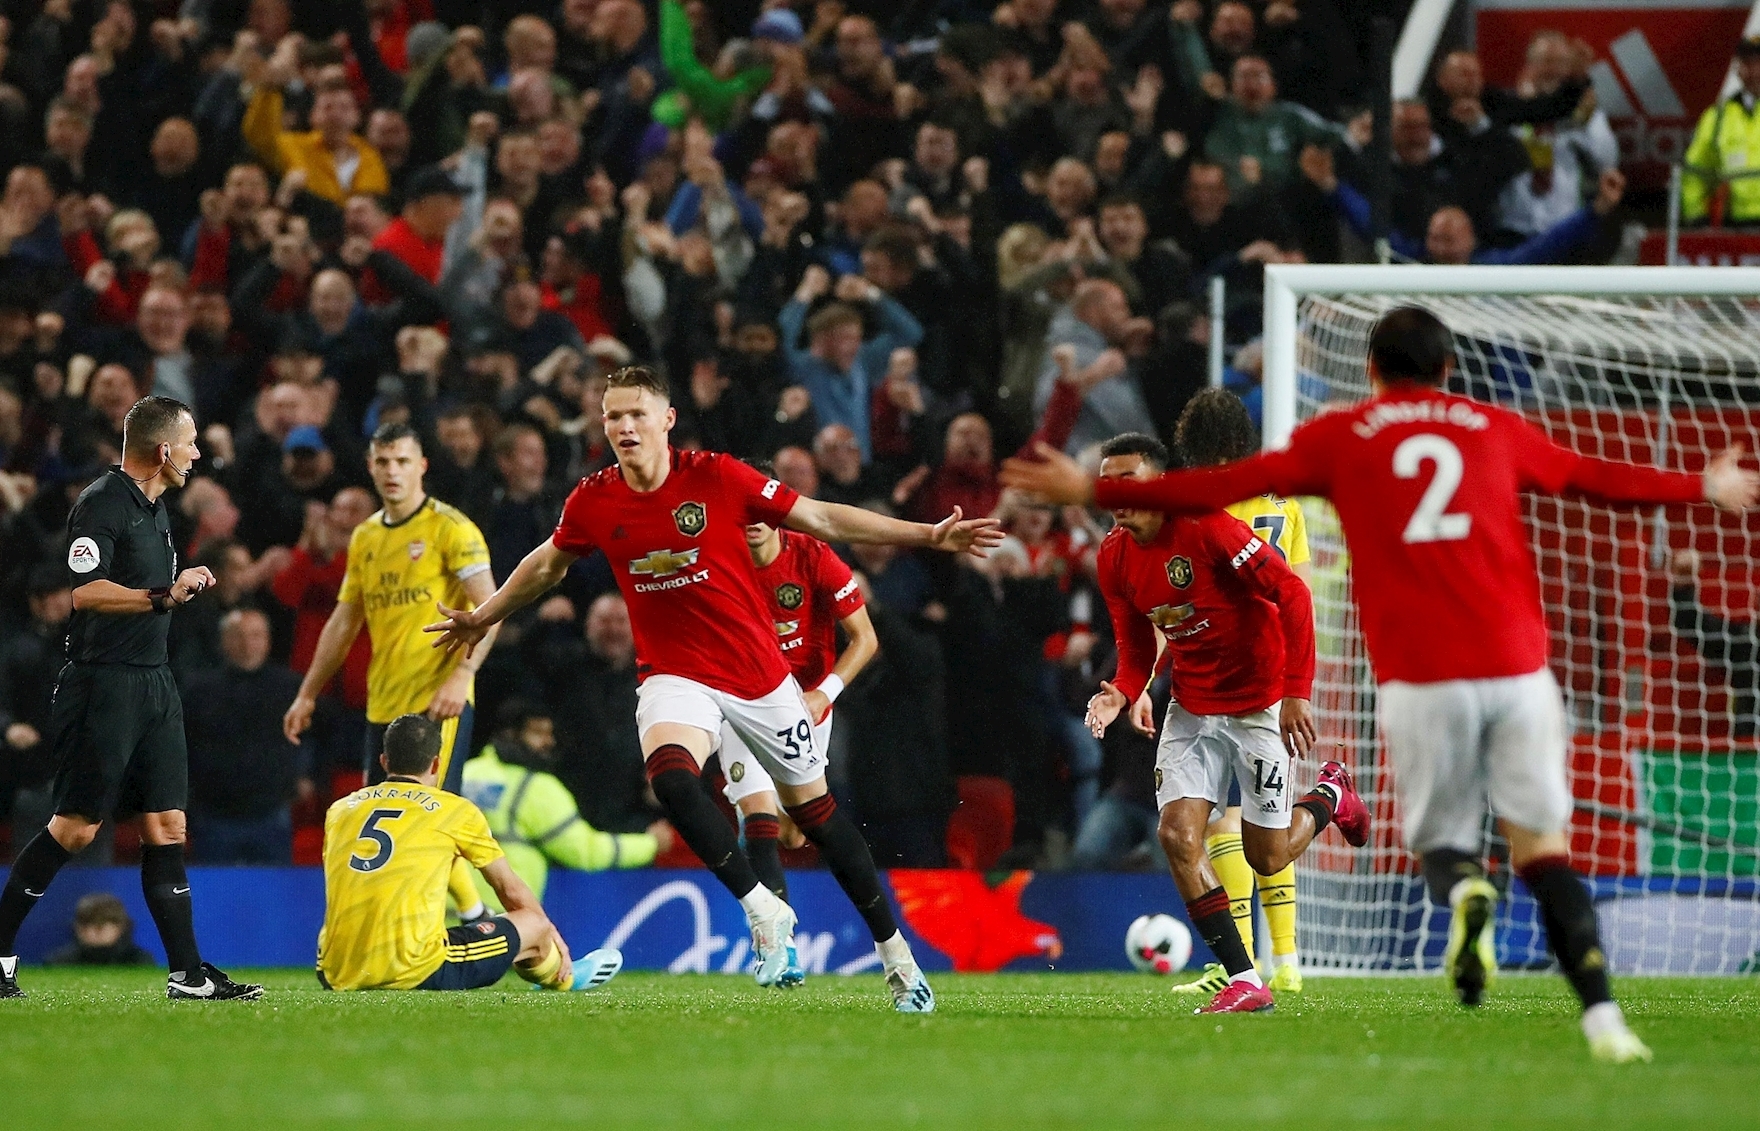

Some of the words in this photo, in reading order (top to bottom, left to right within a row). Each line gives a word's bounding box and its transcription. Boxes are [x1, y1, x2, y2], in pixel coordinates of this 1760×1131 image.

[1391, 433, 1473, 544] 2
[73, 545, 94, 557] EA
[634, 569, 709, 592] CHEVROLET
[777, 719, 813, 759] 39
[1254, 759, 1283, 797] 14
[349, 808, 405, 873] 5
